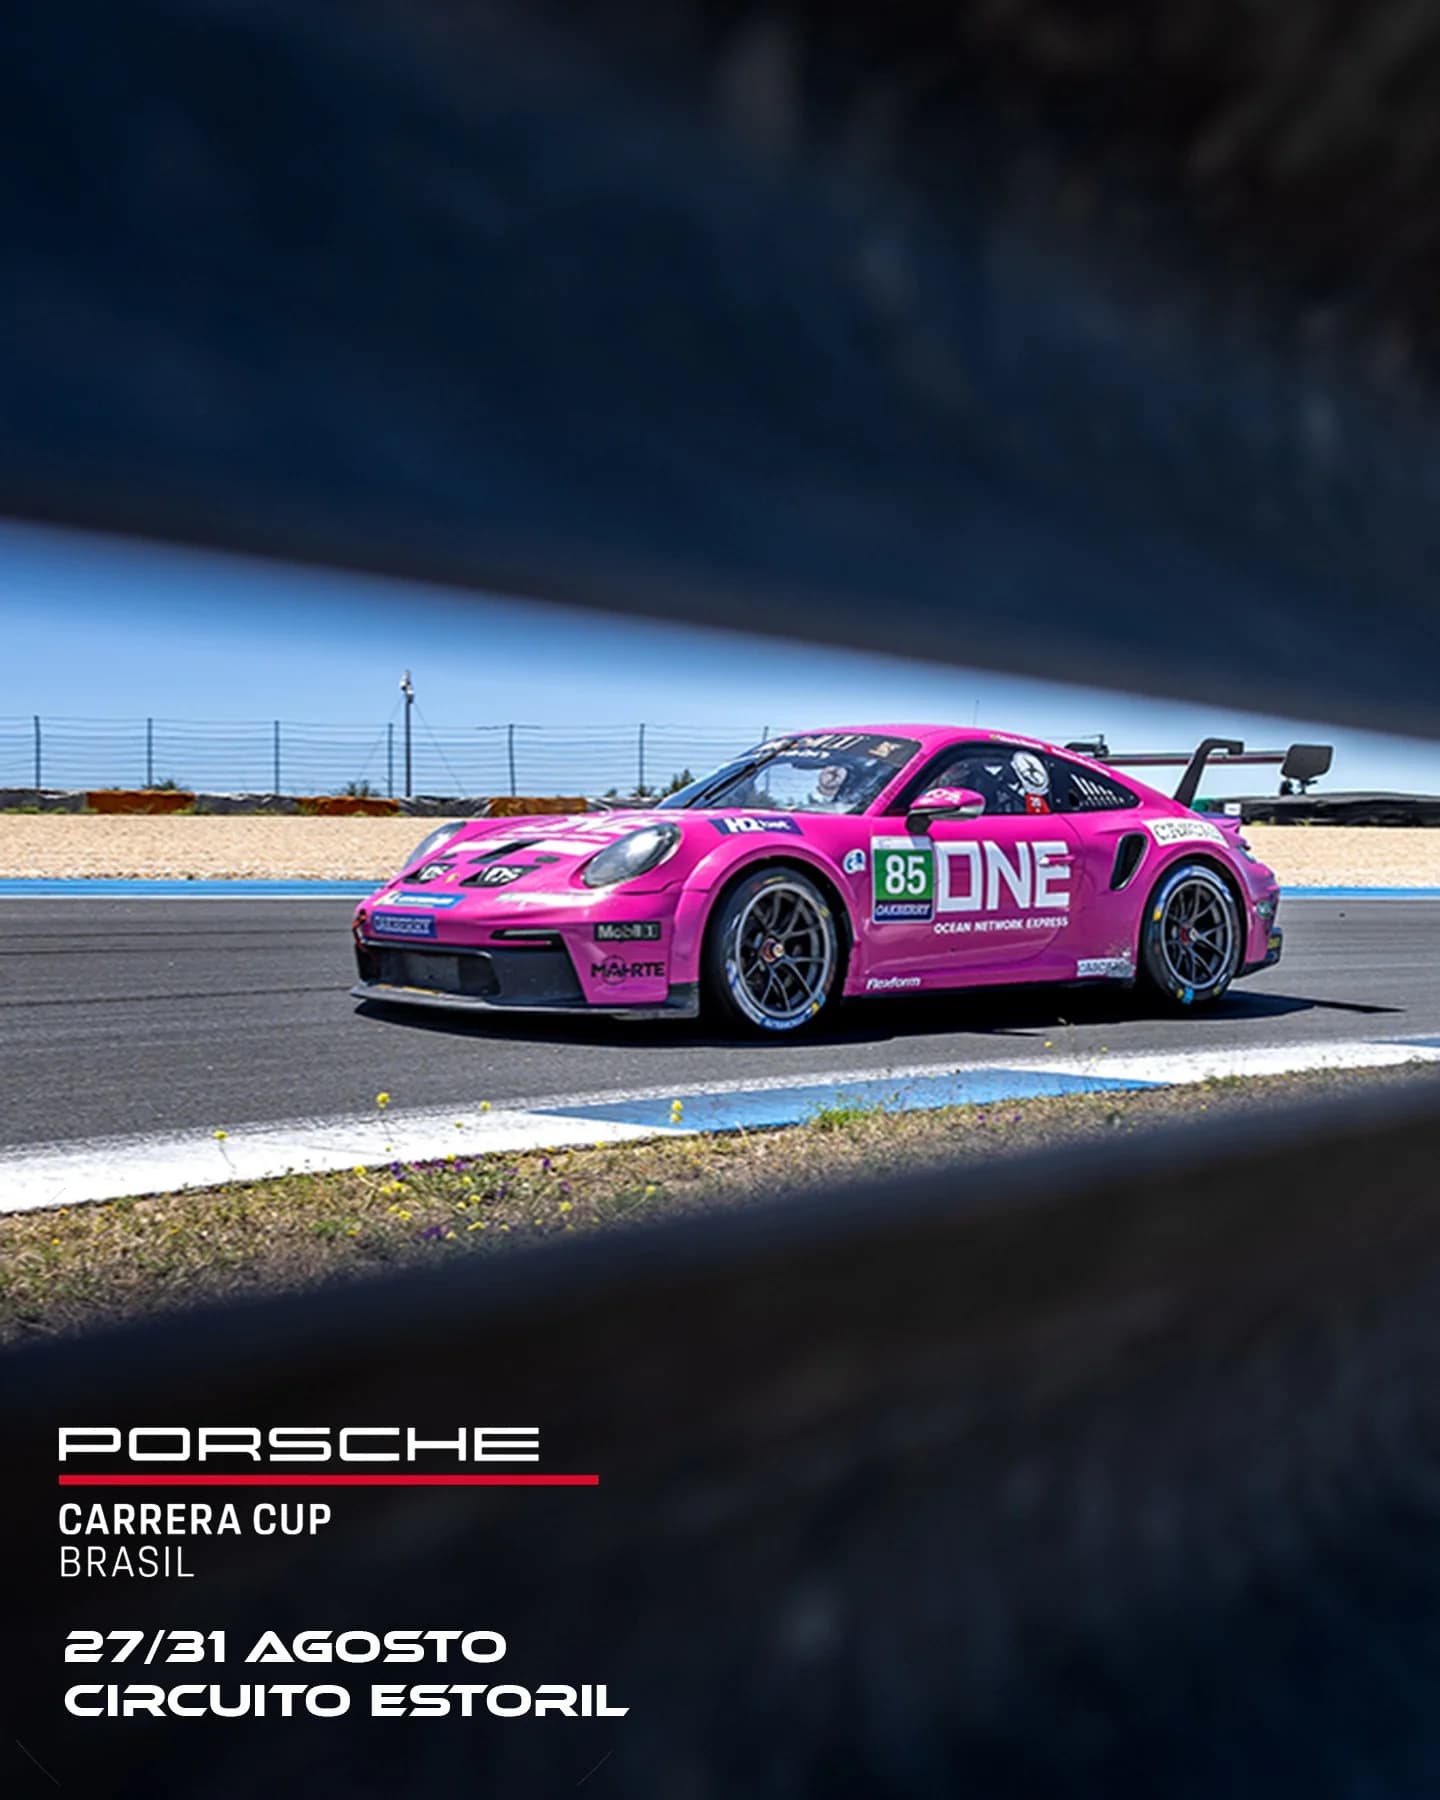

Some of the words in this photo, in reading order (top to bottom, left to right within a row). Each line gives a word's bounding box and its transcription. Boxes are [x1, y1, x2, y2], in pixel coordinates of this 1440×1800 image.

[886, 855, 926, 894] 85
[935, 841, 1070, 912] ONE
[934, 922, 971, 934] OCEAN
[974, 919, 1023, 931] NETWORK
[1026, 916, 1068, 929] EXPRESS
